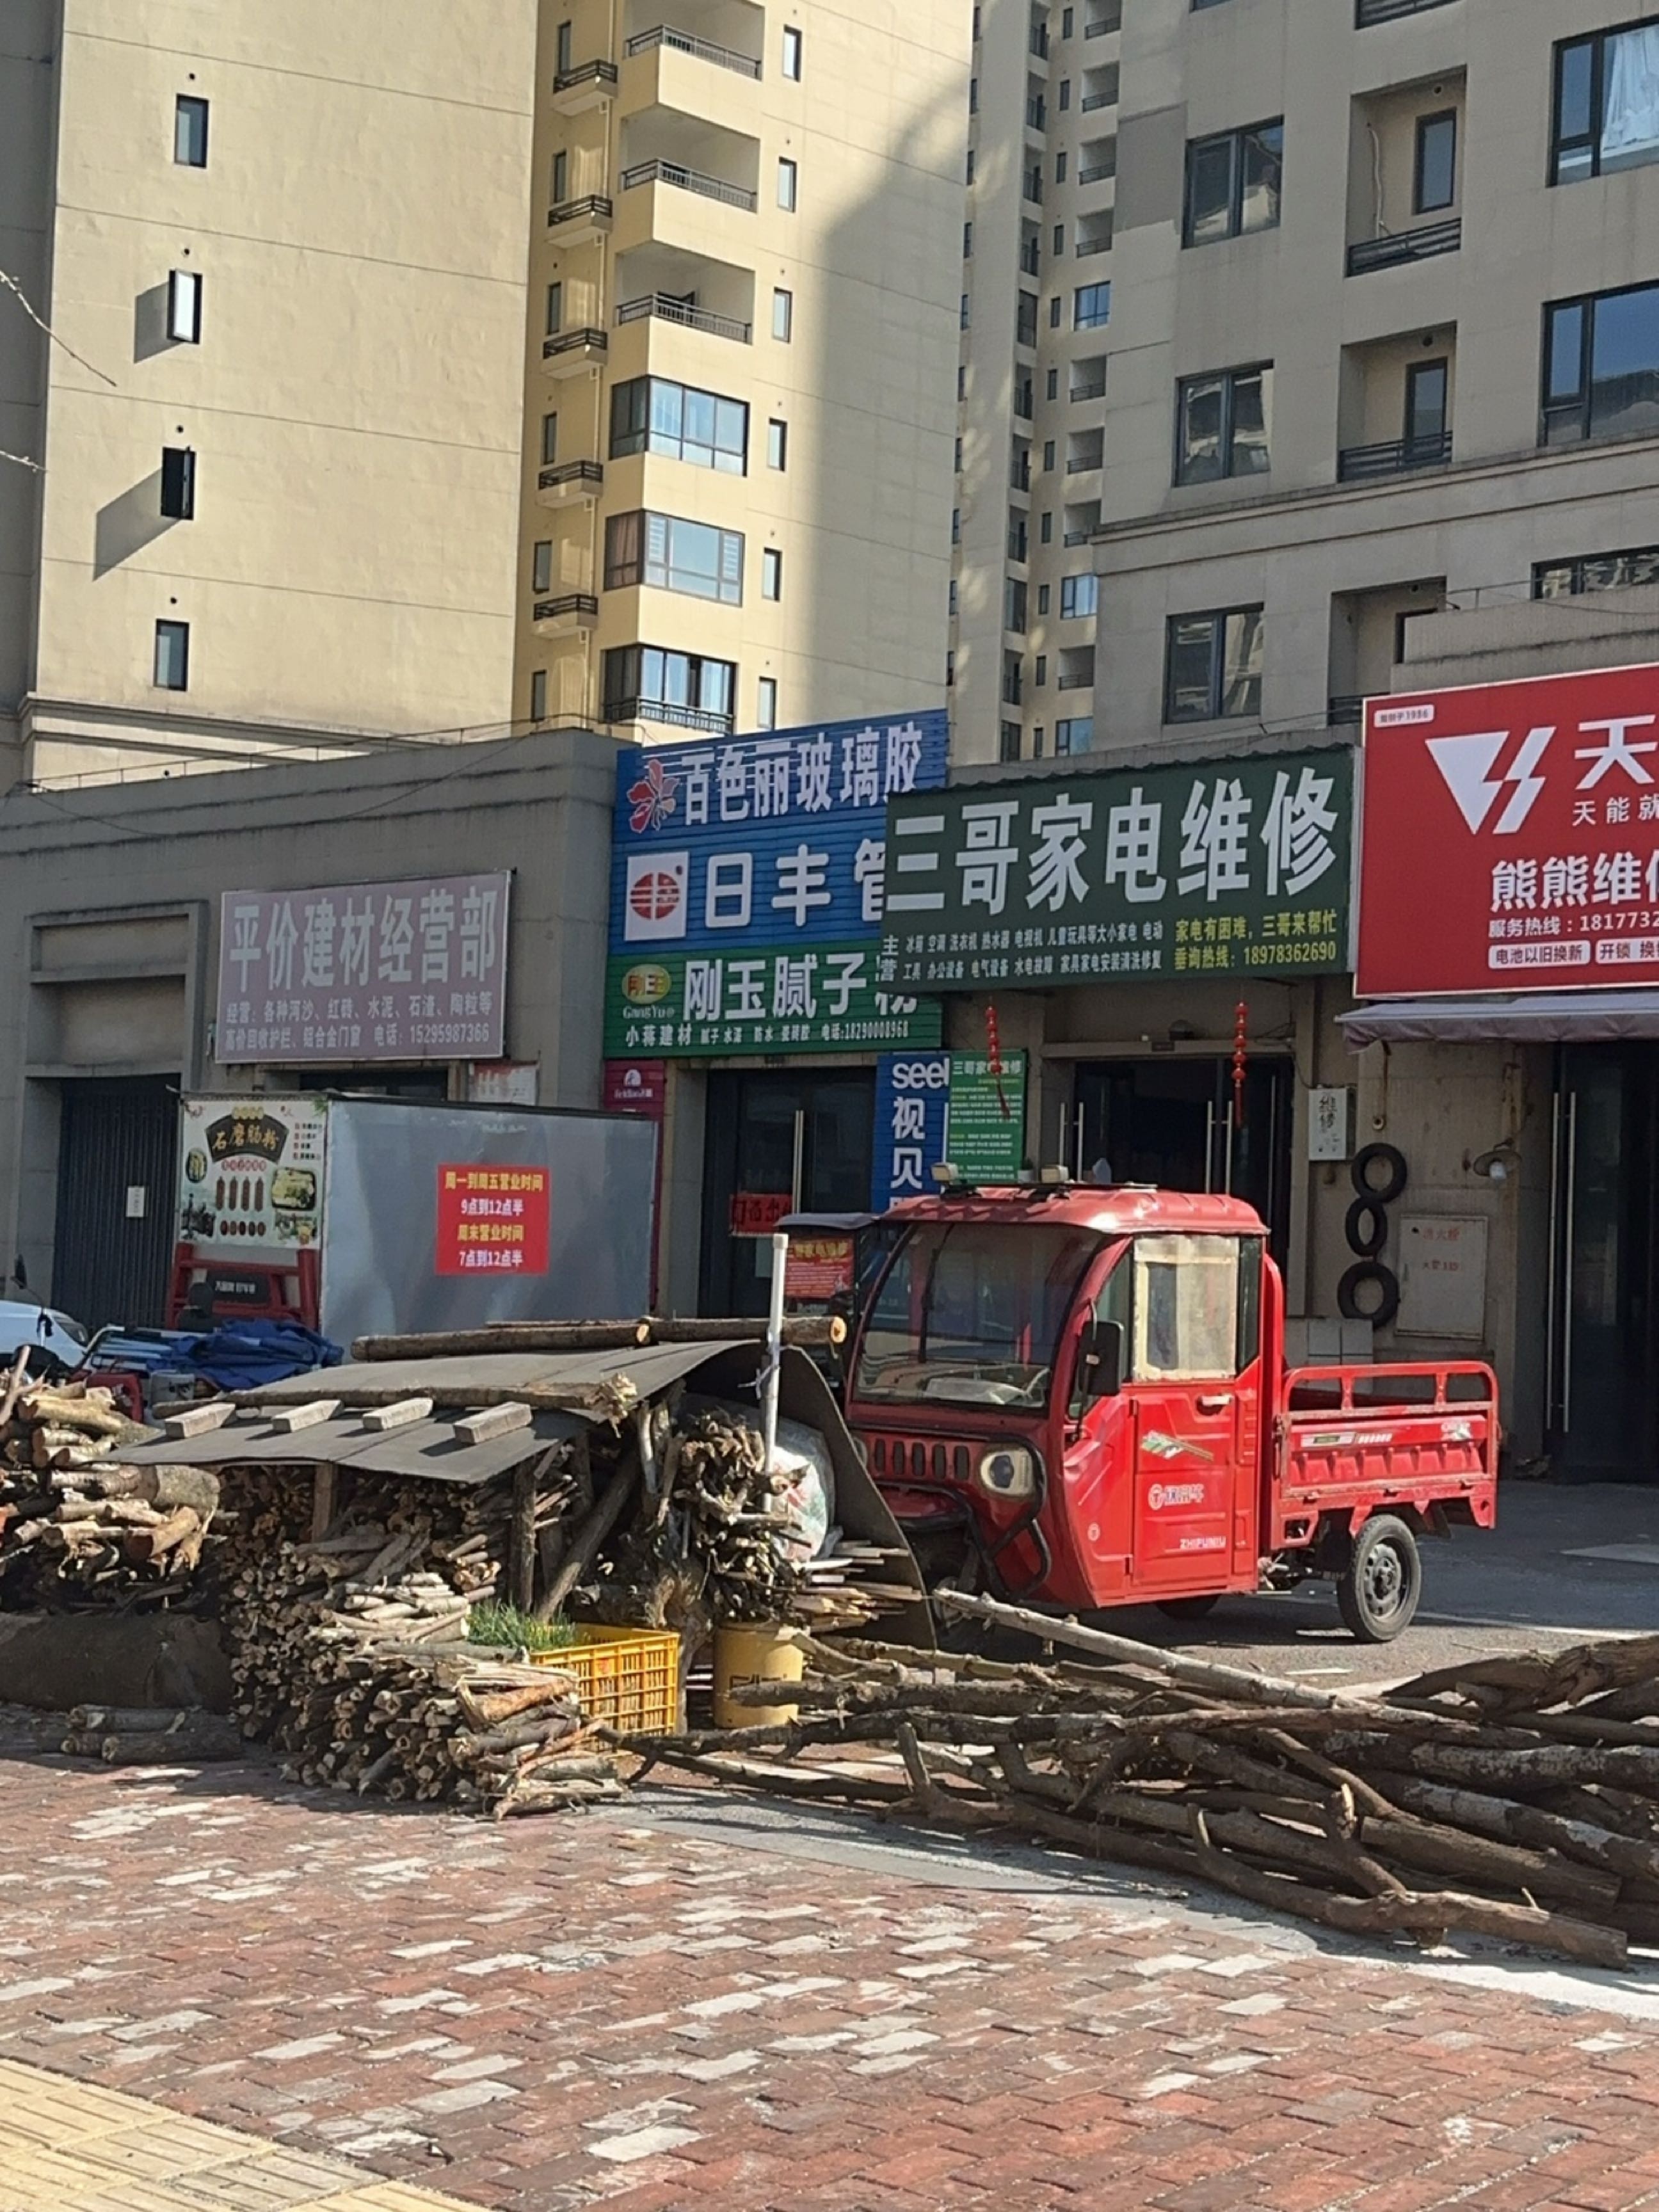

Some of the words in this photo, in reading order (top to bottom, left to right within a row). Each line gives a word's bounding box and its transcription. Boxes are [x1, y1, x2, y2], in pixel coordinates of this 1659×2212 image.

[681, 721, 922, 826] 百色丽玻璃胶
[886, 767, 1338, 915] 三哥家电维修
[229, 885, 499, 993] 平价建材经营部
[949, 931, 977, 952] 洗衣机
[981, 930, 1009, 950] 热水器
[1496, 944, 1583, 965] 电池以旧换新
[1599, 942, 1631, 959] 开锁
[212, 1121, 277, 1151] 石磨肠粉
[445, 1171, 543, 1192] 周一到周五营业时间
[460, 1198, 524, 1216] 9点到12点半
[457, 1224, 525, 1242] 周末营业时间
[459, 1249, 523, 1267] 7点到12点半
